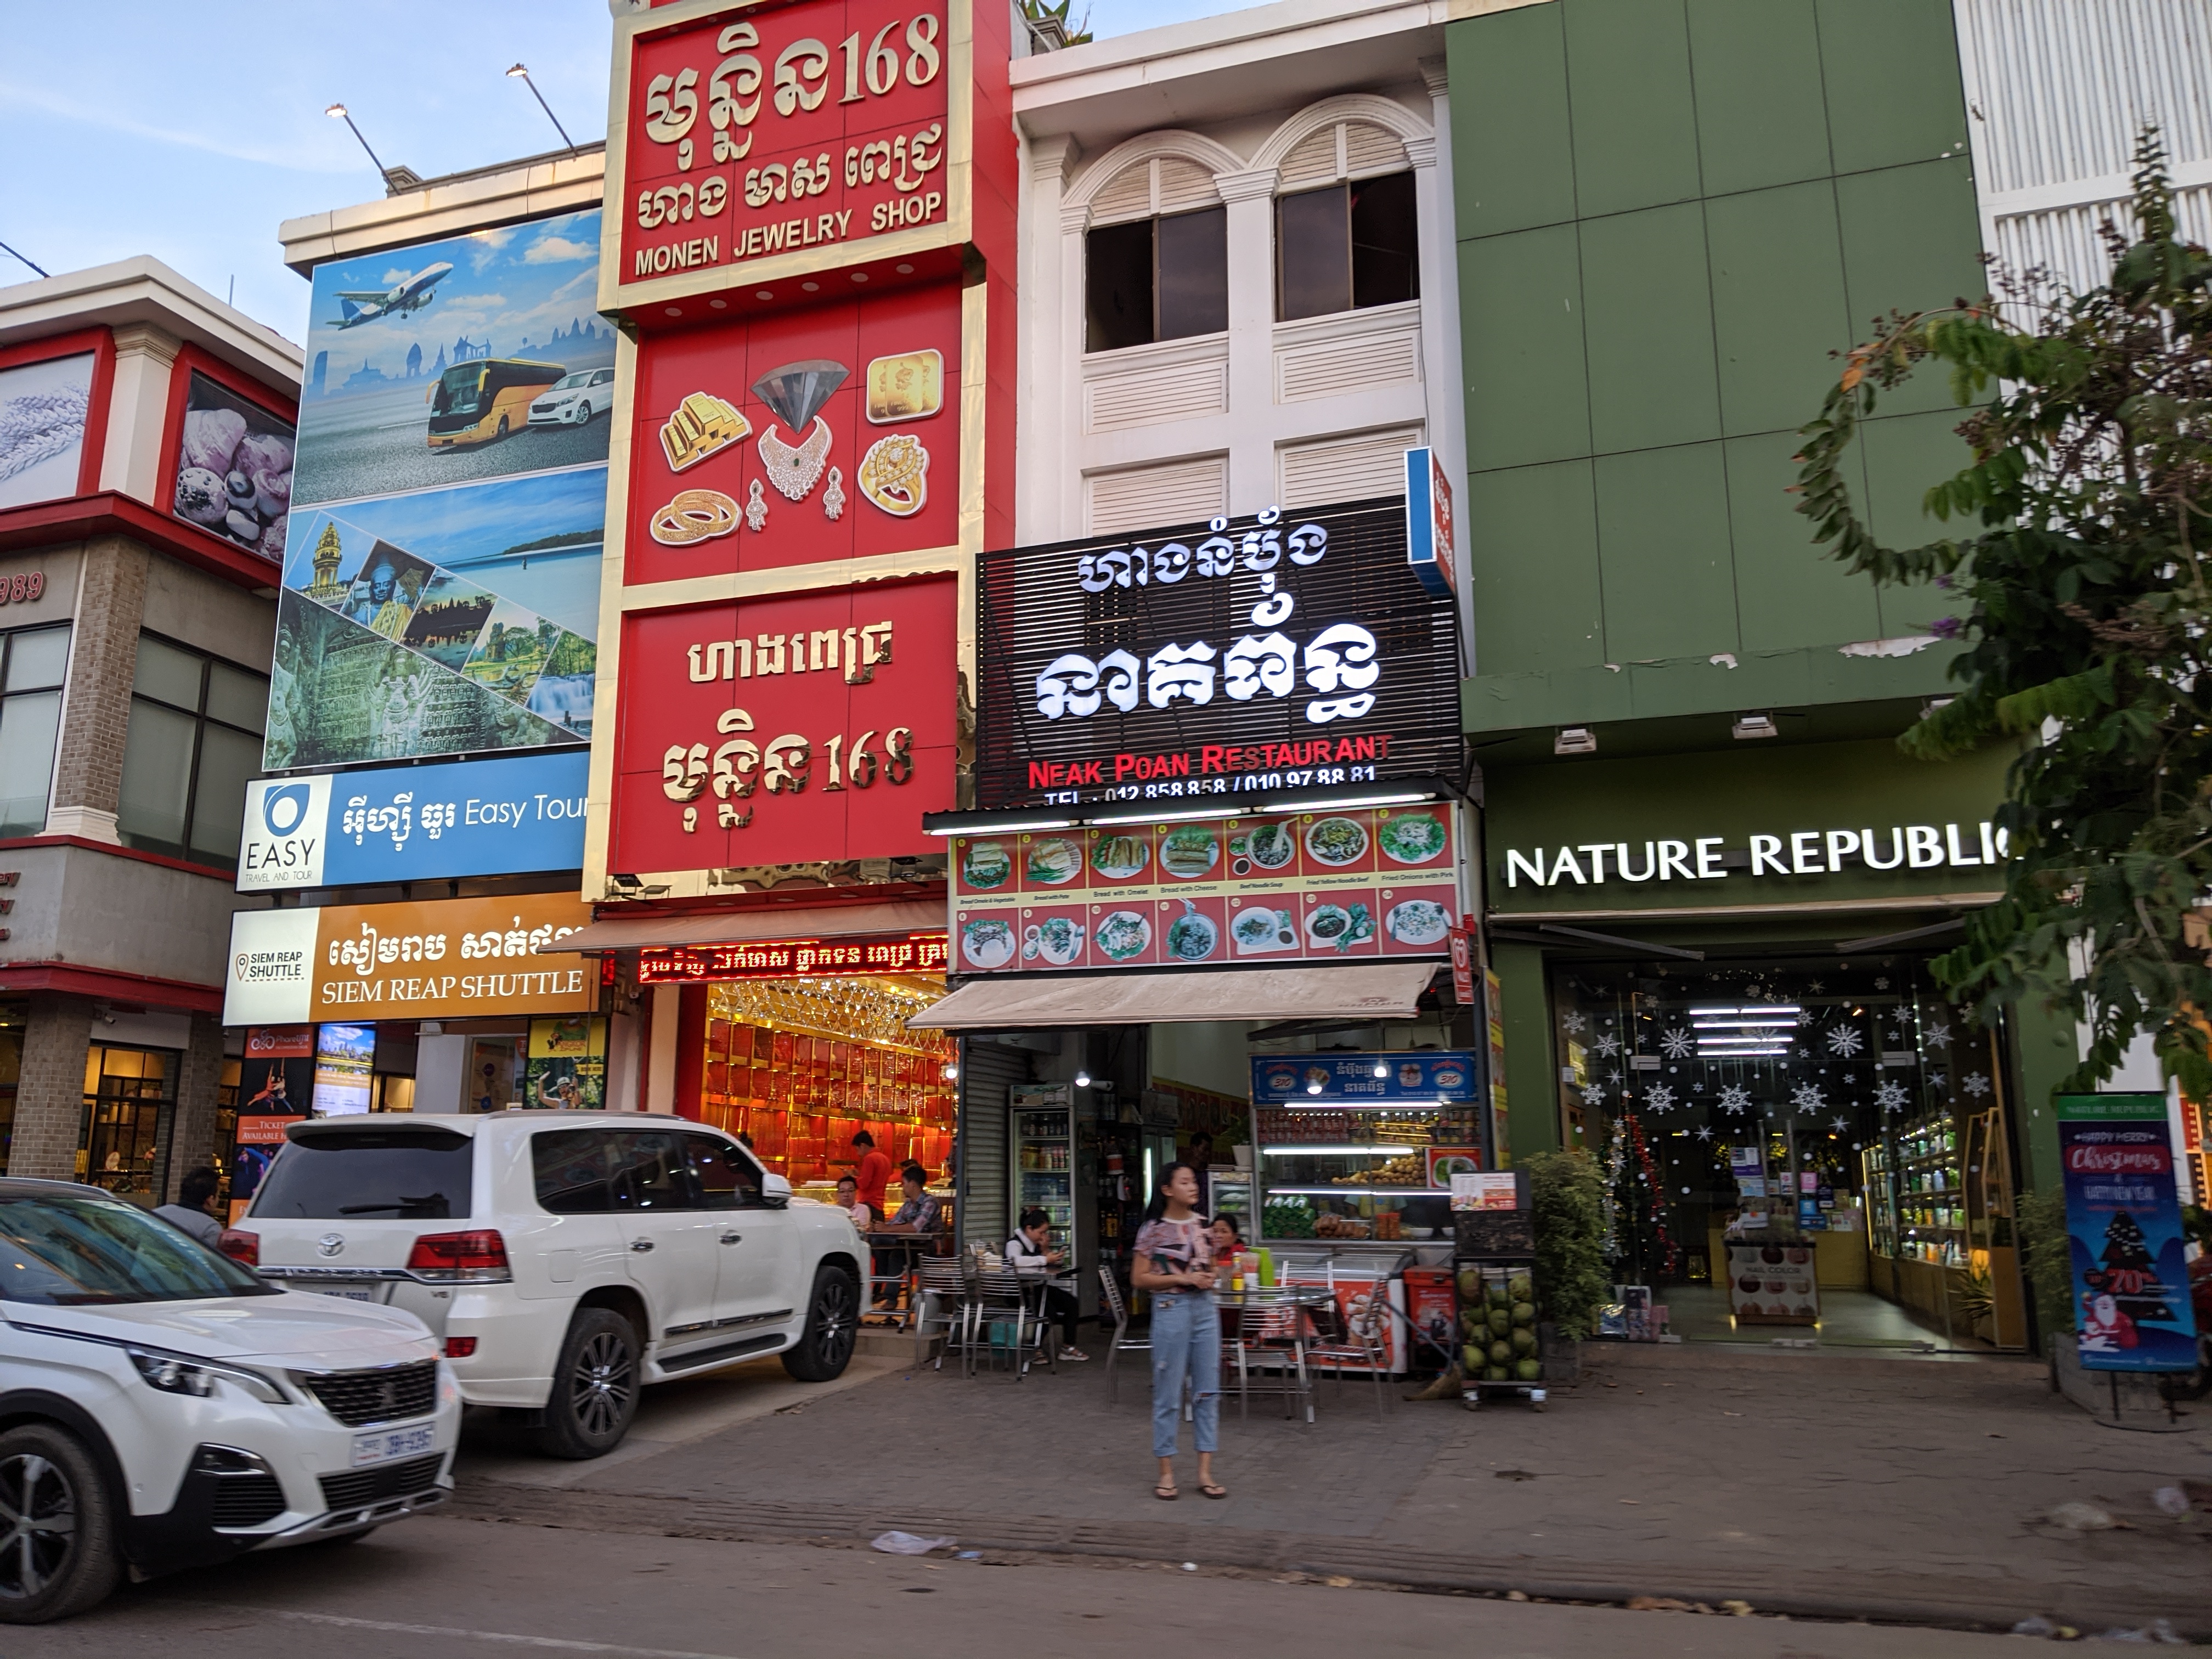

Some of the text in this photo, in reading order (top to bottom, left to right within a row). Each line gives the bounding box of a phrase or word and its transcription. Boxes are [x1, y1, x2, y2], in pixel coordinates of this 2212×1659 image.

[838, 13, 941, 104] 168
[638, 123, 943, 229] ហាង មាស ពេជ្រ
[635, 191, 942, 276] MONEN JEWELRY SHOP
[822, 727, 915, 791] 168
[1029, 735, 1393, 789] NEAK POAN RESTAURANT
[1286, 770, 1313, 788] 97
[1317, 768, 1345, 785] 88
[1350, 765, 1375, 782] 81
[465, 798, 527, 828] Easy
[246, 838, 317, 870] EASY
[1506, 837, 1729, 889] NATURE
[245, 870, 313, 883] TRAVEL AND TOUR
[251, 951, 303, 964] SIEM REAP
[329, 922, 447, 976] សៀមរាប
[249, 964, 302, 978] SHUTTLE
[321, 970, 584, 1005] SIEM REAP SHUTTLE
[259, 1121, 286, 1129] TICKET
[2071, 1147, 2161, 1170] Christmas
